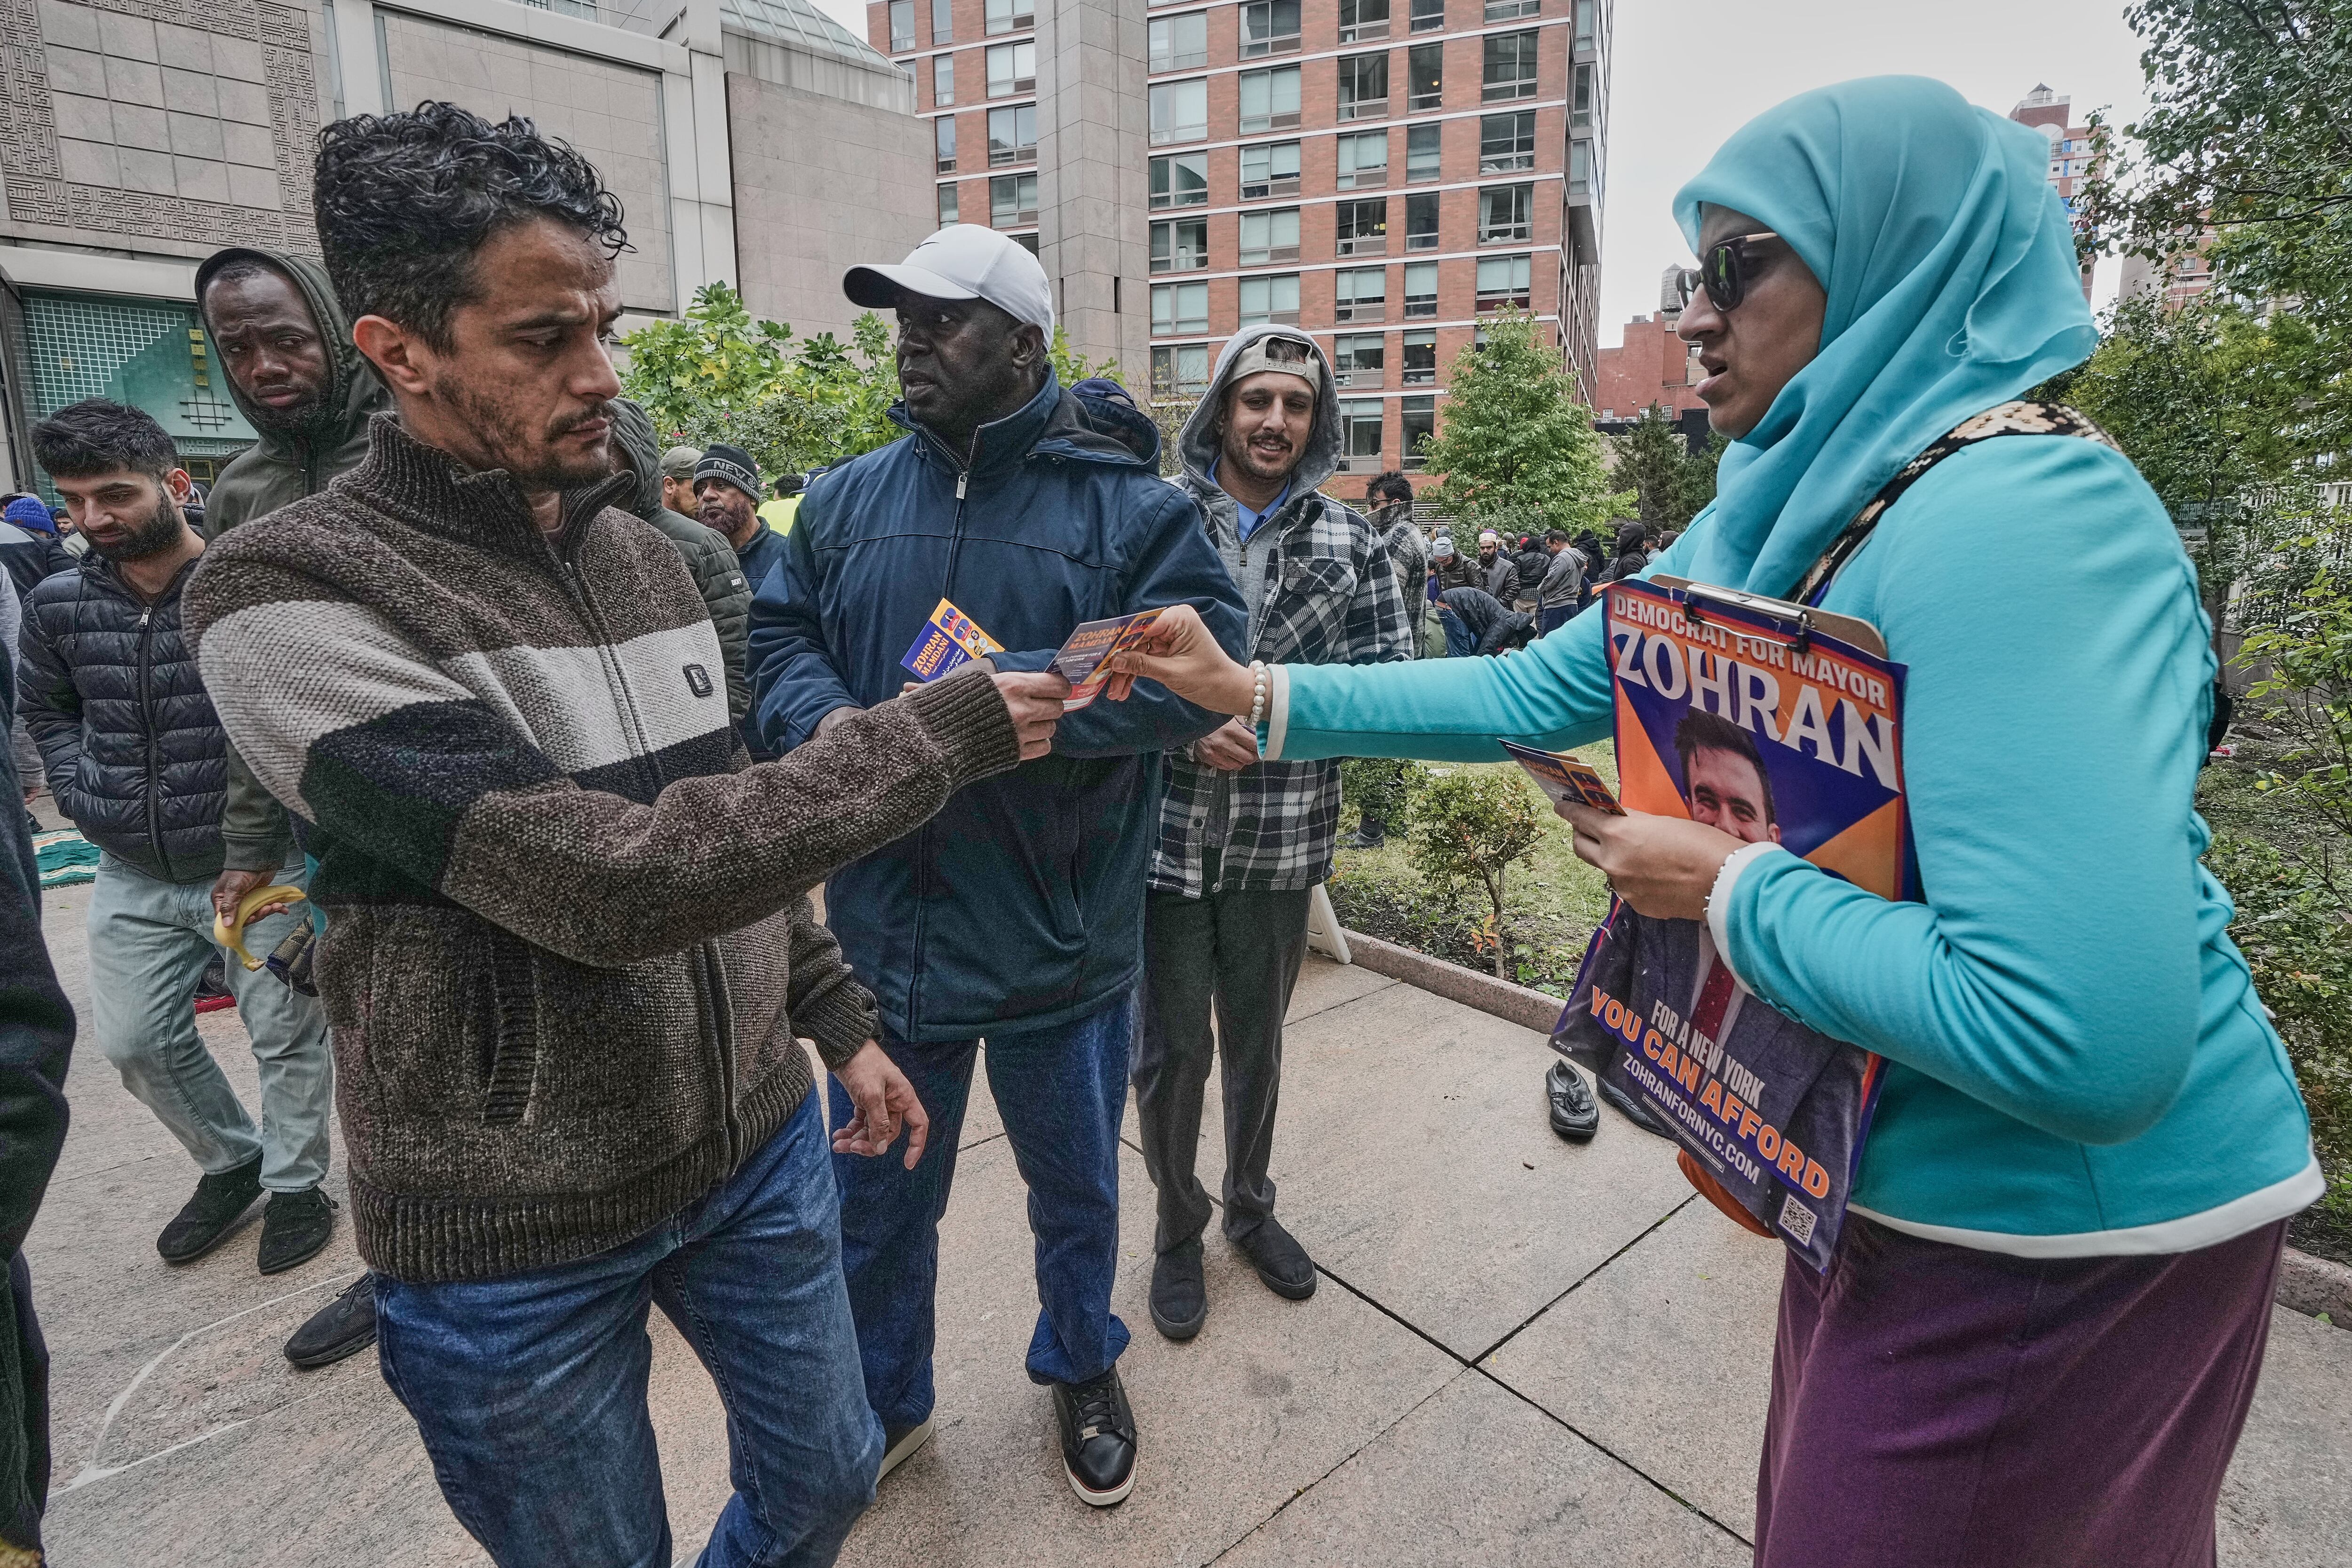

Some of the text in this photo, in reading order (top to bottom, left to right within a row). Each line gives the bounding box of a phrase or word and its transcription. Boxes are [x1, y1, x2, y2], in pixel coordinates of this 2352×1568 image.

[713, 461, 746, 479] NEW
[731, 578, 742, 586] DKNY
[913, 630, 943, 671] ZOHRAN
[921, 637, 949, 677] MAMDANI
[1073, 625, 1126, 643] ZOHRAN
[1614, 594, 1886, 709] DEMOCRAT FOR MAYOR
[1610, 619, 1902, 794] ZOHRAN
[1651, 999, 1765, 1109] FOR A NEW YORK
[1590, 985, 1642, 1042] YOU
[1643, 1029, 1700, 1094] CAN
[1699, 1078, 1830, 1199] AFFORD
[1623, 1052, 1760, 1185] ZOHRANFORNYC.COM
